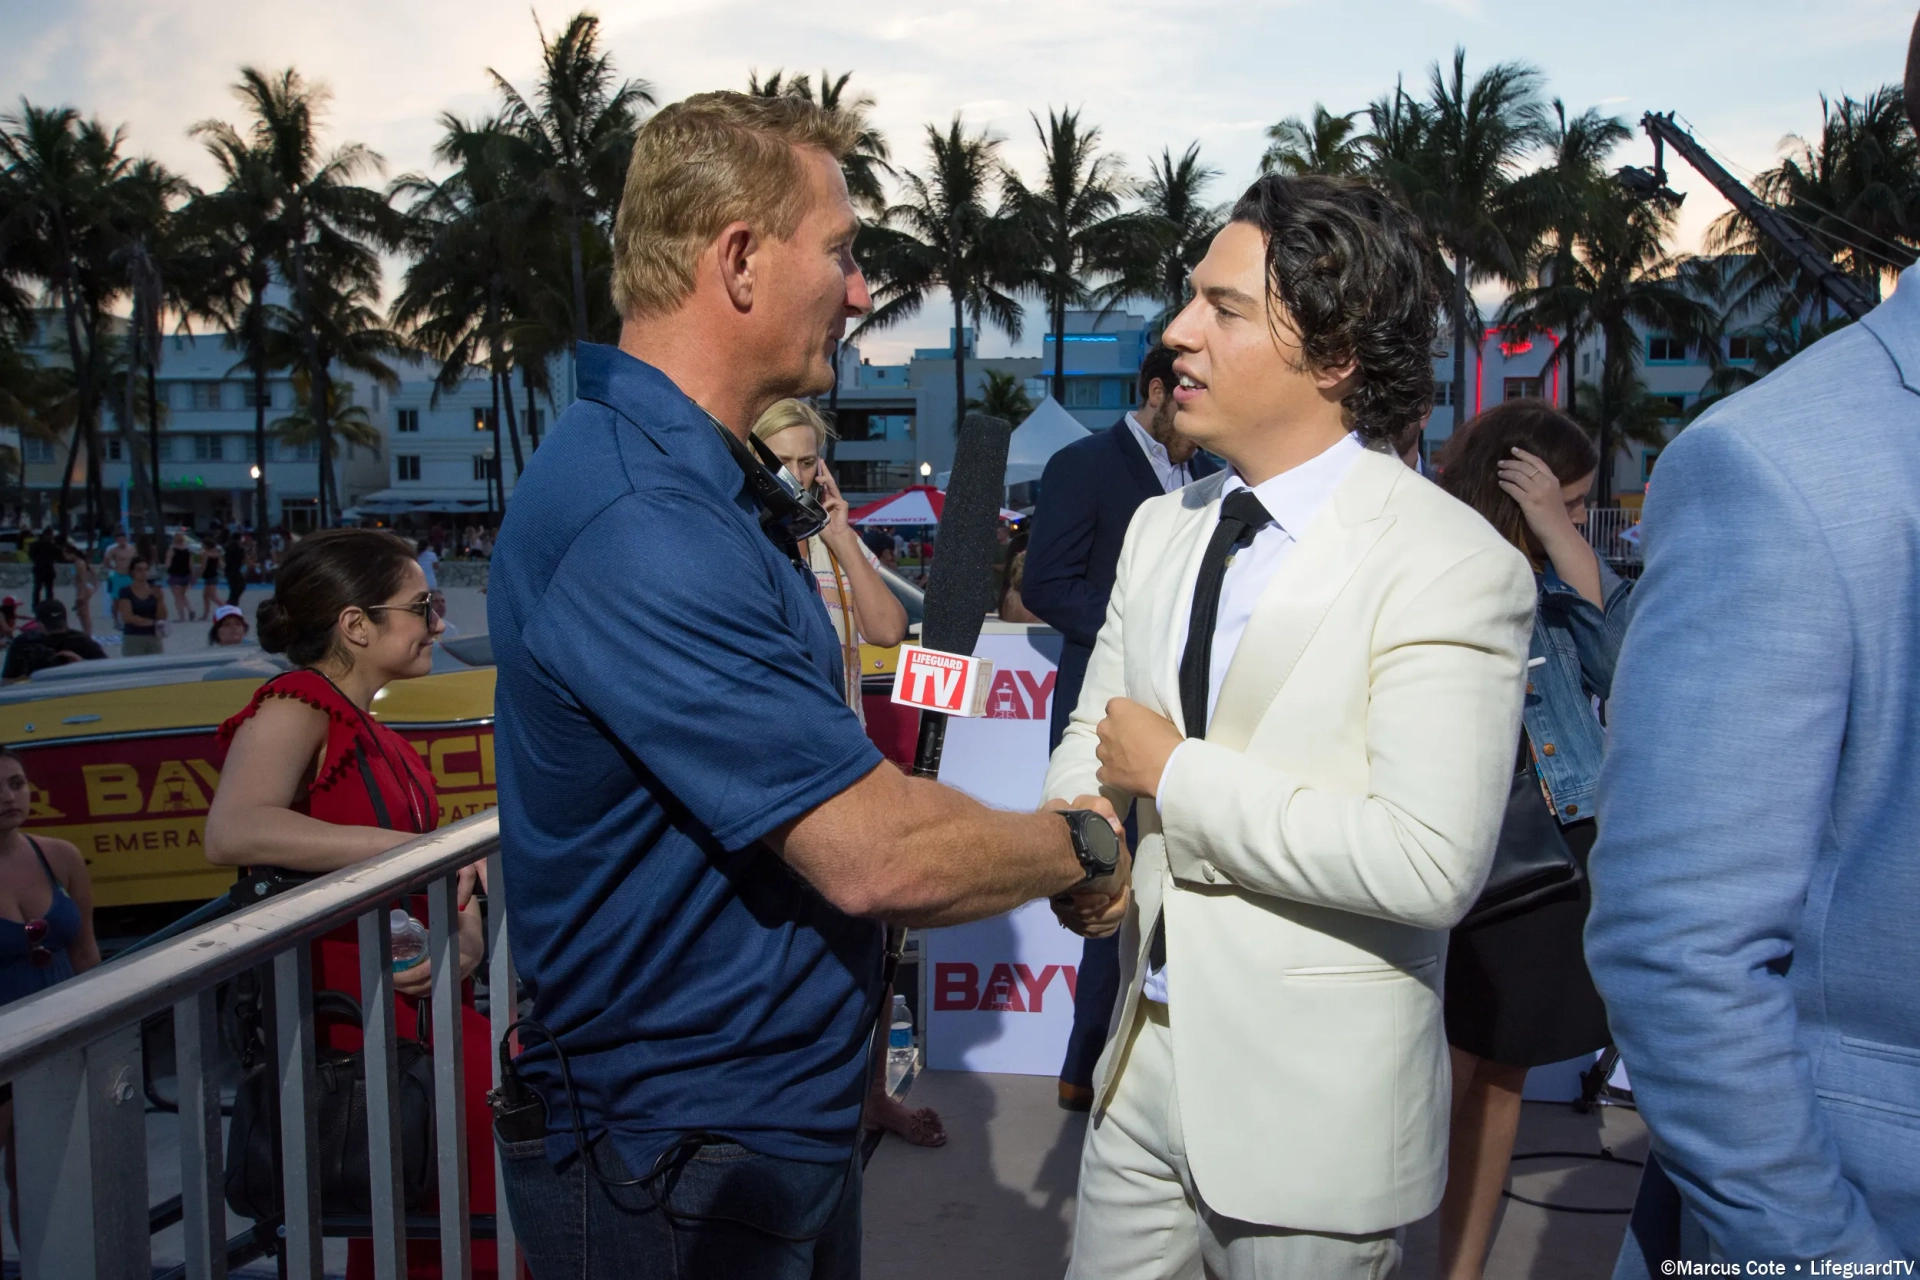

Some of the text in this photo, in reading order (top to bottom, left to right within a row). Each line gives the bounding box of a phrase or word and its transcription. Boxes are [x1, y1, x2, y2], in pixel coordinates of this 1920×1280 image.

[911, 652, 964, 671] LIFEGUARD
[909, 663, 962, 708] TV
[981, 669, 1058, 720] AY
